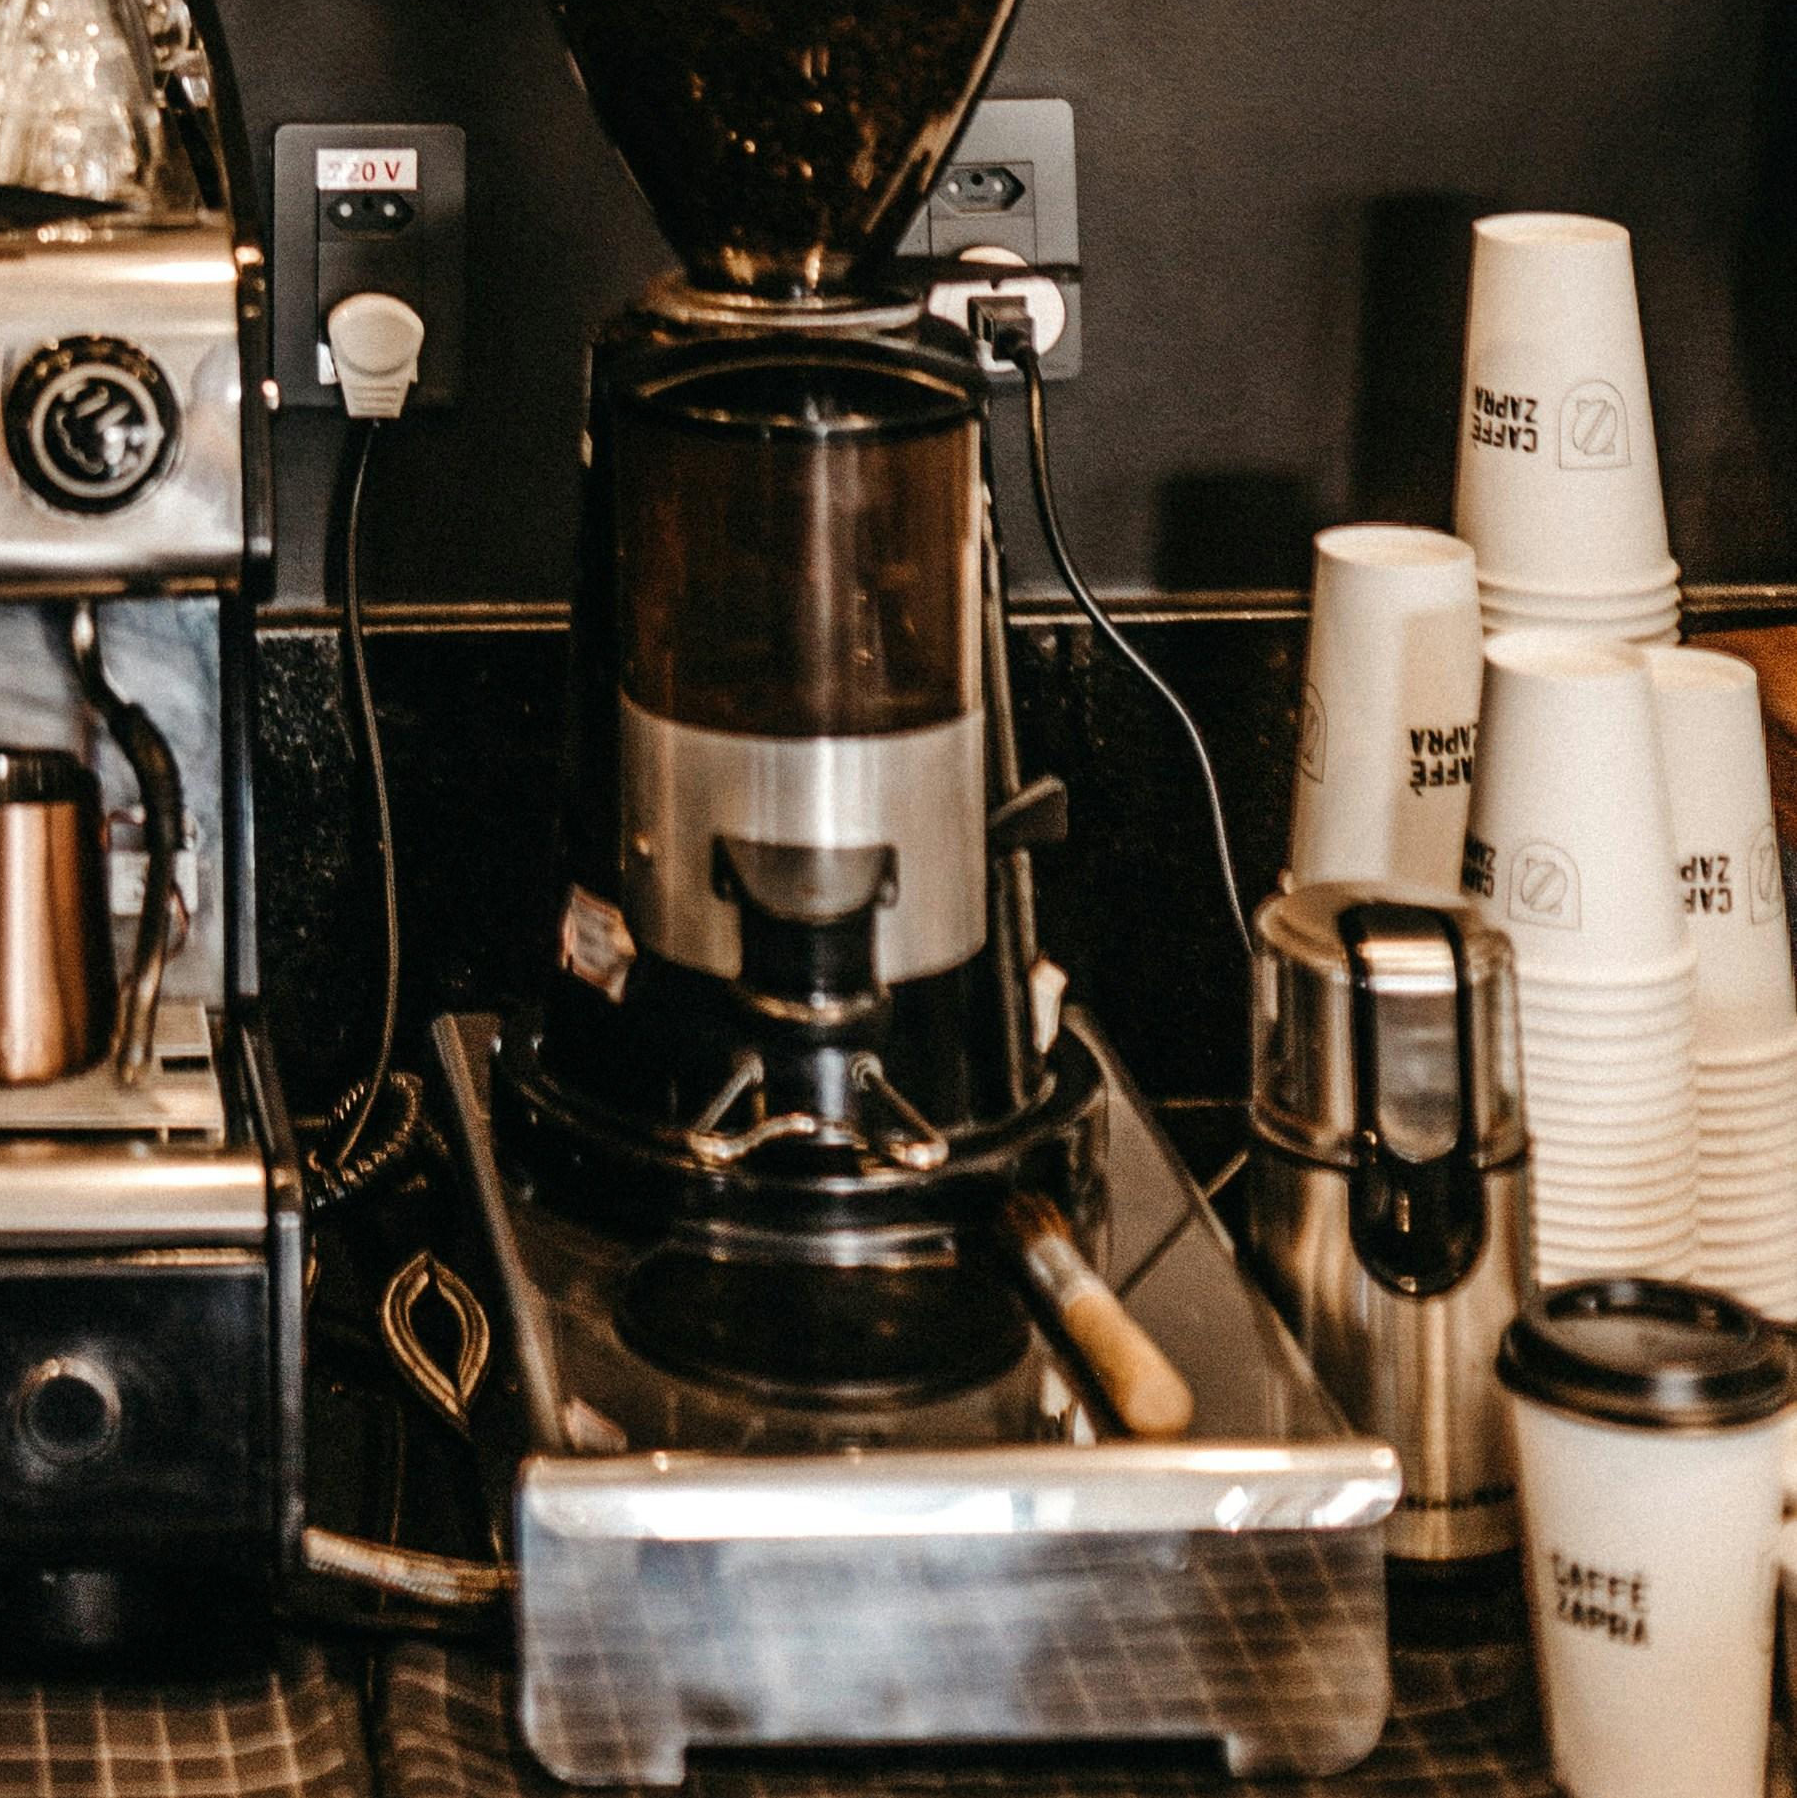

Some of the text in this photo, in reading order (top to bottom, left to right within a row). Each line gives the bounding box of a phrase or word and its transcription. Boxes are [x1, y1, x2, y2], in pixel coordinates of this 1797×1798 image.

[384, 161, 401, 182] V
[1474, 386, 1538, 423] ZAPRA
[1410, 726, 1476, 756] APRA
[1409, 755, 1473, 796] AFFÈ
[1680, 855, 1731, 883] ZAP
